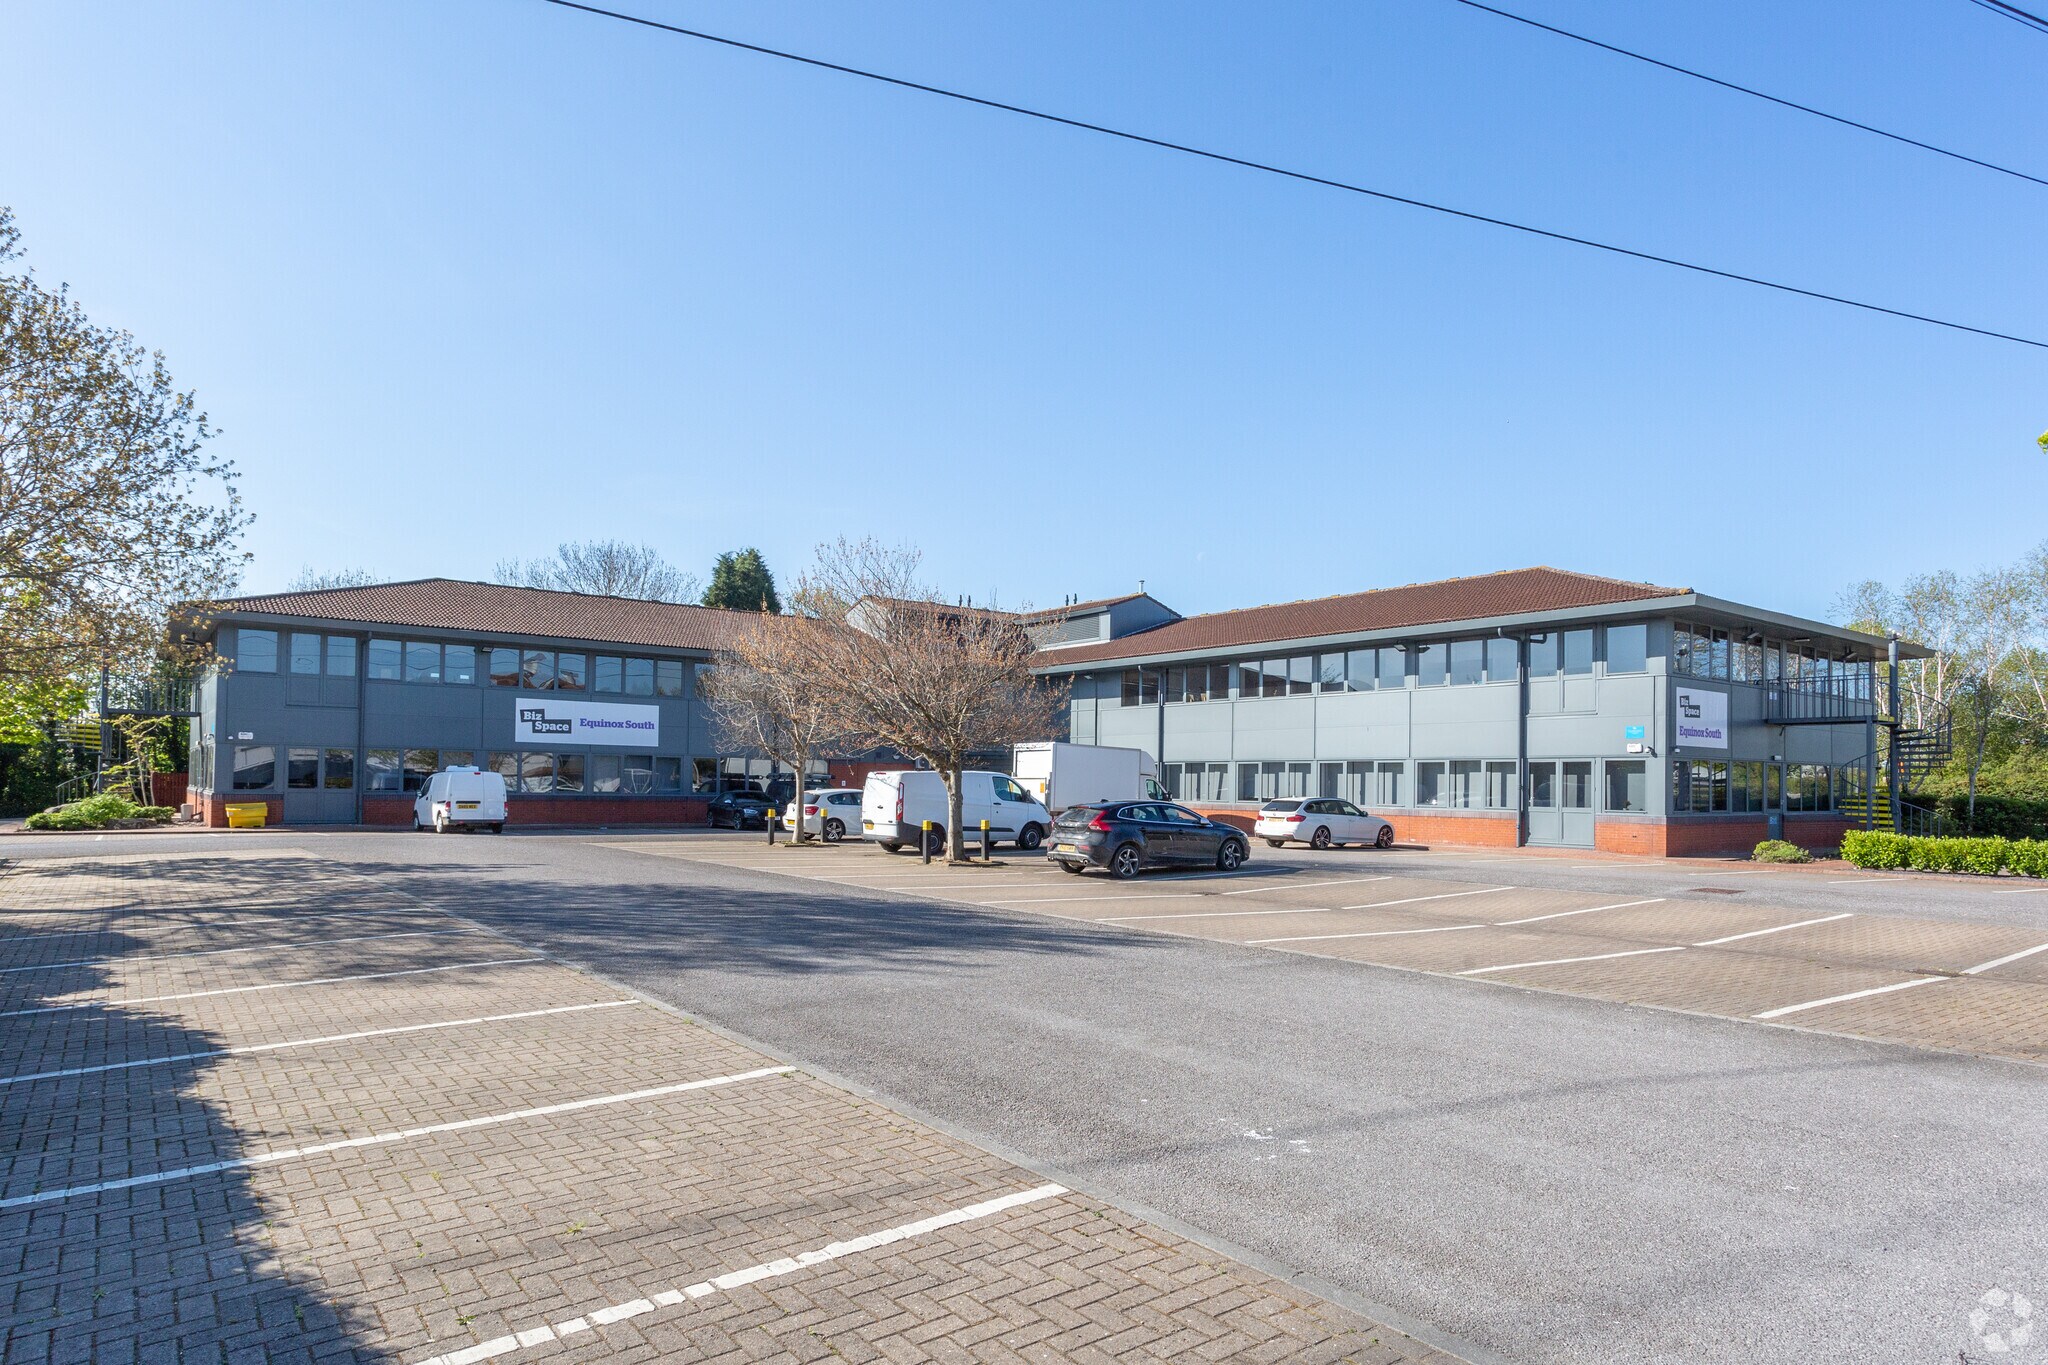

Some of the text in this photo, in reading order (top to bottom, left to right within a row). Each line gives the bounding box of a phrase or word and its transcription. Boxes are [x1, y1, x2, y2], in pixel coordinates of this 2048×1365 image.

[523, 711, 542, 721] Biz
[534, 721, 570, 732] Space
[580, 718, 655, 730] Equinox South
[1680, 725, 1722, 739] Equinox South
